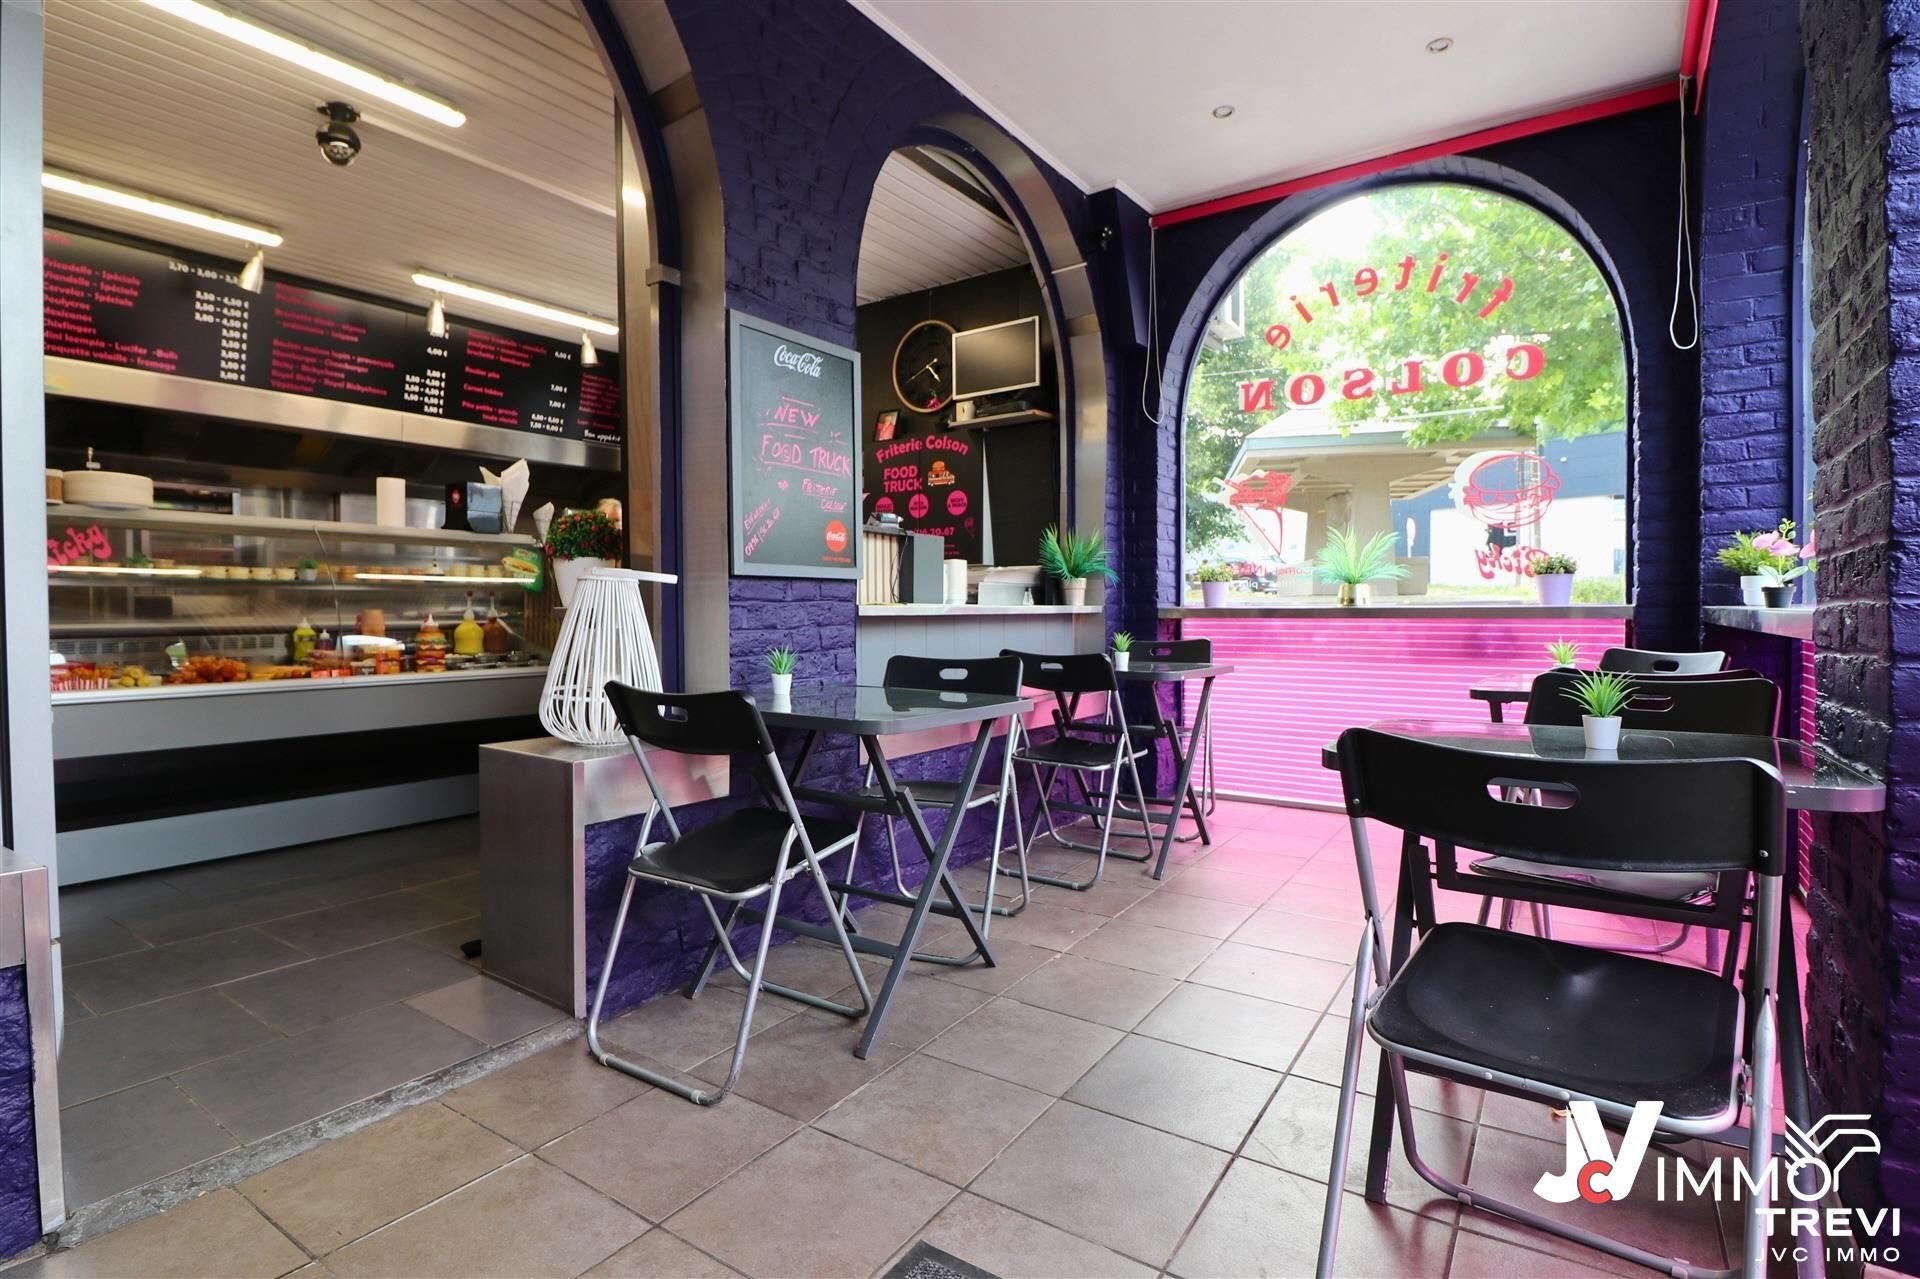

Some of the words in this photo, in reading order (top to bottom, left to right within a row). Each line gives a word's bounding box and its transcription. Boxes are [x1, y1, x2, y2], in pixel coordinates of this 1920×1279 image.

[774, 345, 823, 377] Coca-Cola
[774, 404, 821, 427] NEW
[761, 434, 802, 465] FOOD
[809, 446, 852, 478] TRUCK
[876, 438, 922, 463] Friterie
[925, 435, 969, 456] Colson
[883, 465, 918, 480] FOOD
[884, 479, 922, 493] TRUCK
